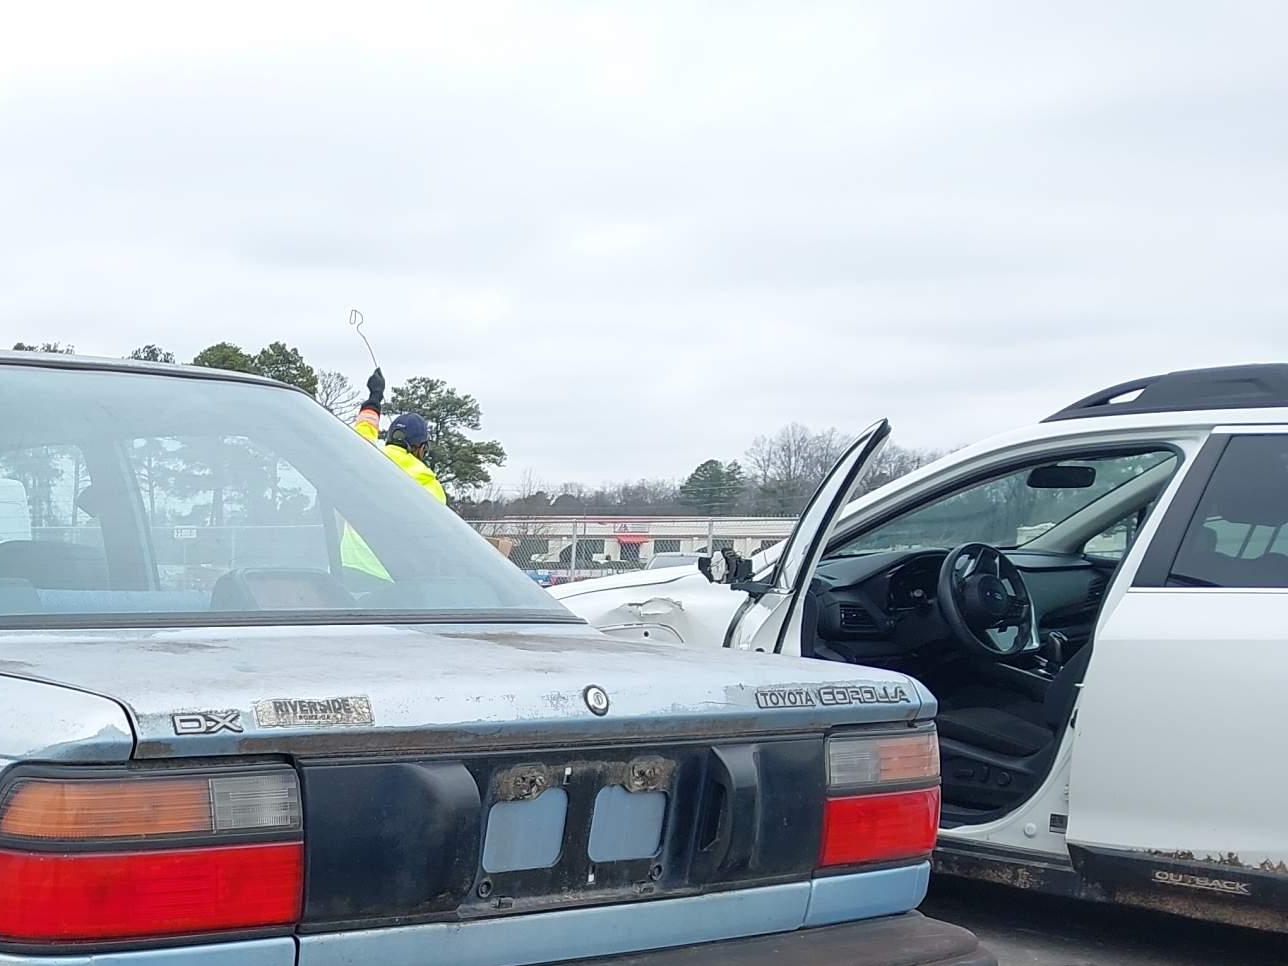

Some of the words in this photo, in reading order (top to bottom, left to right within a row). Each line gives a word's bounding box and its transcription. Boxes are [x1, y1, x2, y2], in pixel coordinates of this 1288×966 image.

[762, 691, 815, 706] TOYOTA
[818, 686, 911, 706] COROLLA
[272, 699, 354, 715] RIVERSIDE
[172, 712, 244, 735] DX
